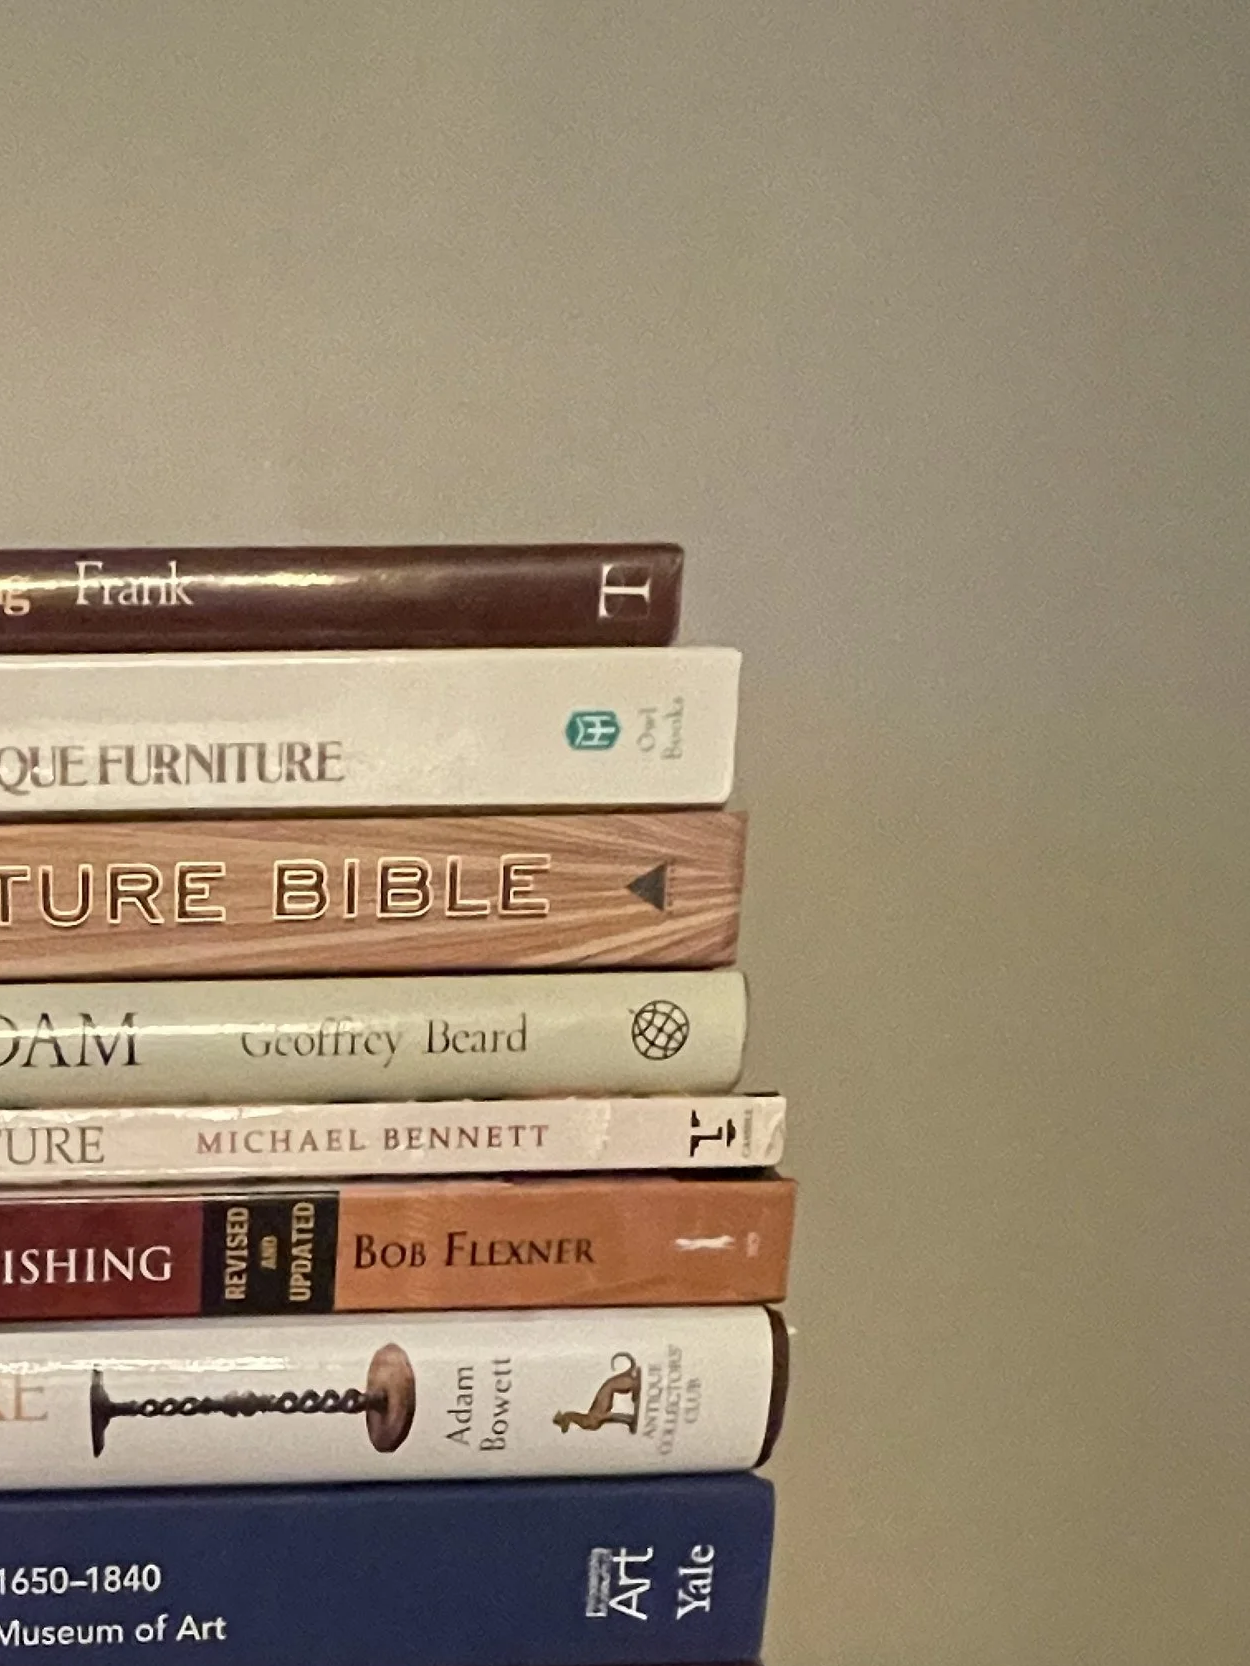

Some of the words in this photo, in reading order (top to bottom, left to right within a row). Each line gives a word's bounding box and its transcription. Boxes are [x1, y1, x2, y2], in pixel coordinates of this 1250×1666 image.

[74, 560, 193, 608] Frank
[98, 740, 343, 787] FURNITURE
[273, 853, 552, 920] BIBLE
[241, 1020, 403, 1068] Geoffrey
[425, 1015, 527, 1056] Beard
[196, 1128, 366, 1155] MICHAEL
[383, 1123, 550, 1151] BENNETT
[224, 1206, 250, 1301] REVISED
[261, 1235, 278, 1271] AND
[290, 1201, 315, 1302] UPDATED
[445, 1227, 596, 1269] FLEXNER
[446, 1364, 474, 1446] Adam
[480, 1356, 513, 1452] Bowett
[642, 1363, 662, 1439] ANTIQUE
[685, 1376, 702, 1424] CLUB
[608, 1546, 654, 1621] Art
[676, 1544, 716, 1621] Yale
[134, 1613, 170, 1644] of
[176, 1613, 228, 1643] Art
